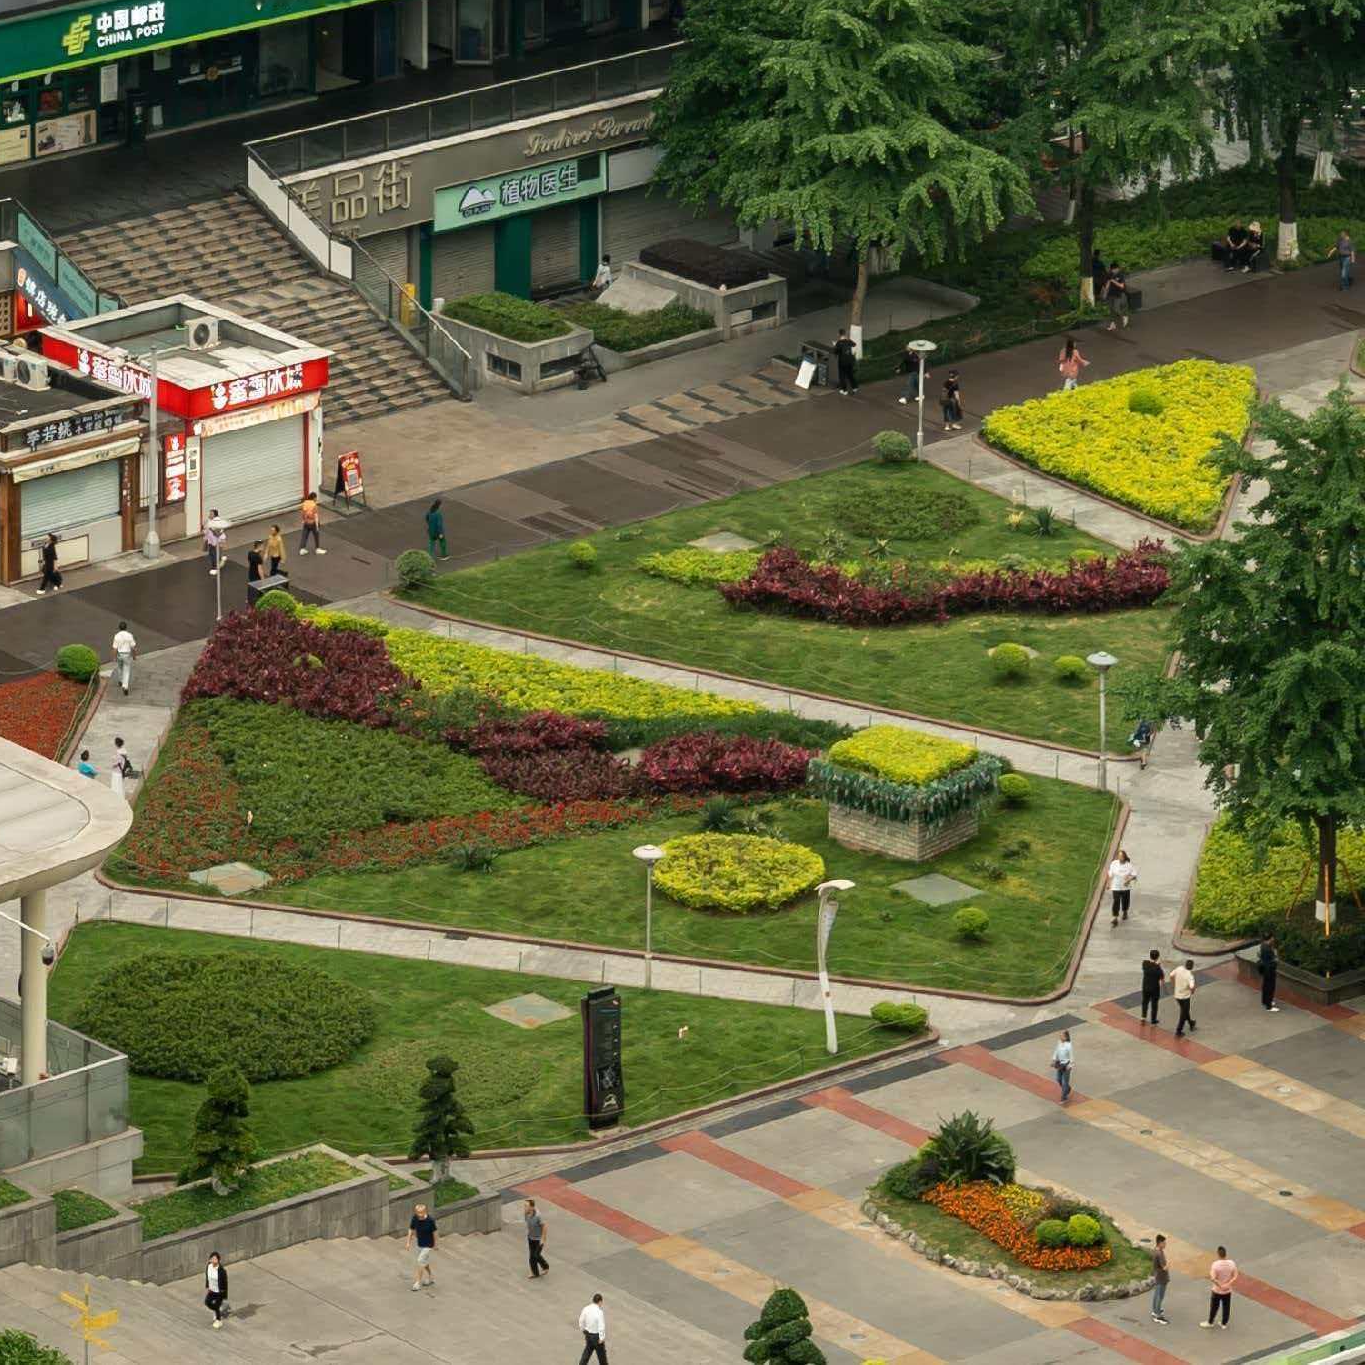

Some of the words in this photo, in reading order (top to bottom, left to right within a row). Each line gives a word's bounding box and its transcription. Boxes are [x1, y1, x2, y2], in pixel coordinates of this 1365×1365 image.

[96, 0, 166, 32] 中国邮政
[96, 29, 132, 48] CHINA
[135, 21, 166, 41] POST
[500, 165, 579, 207] 植物医生
[228, 363, 303, 405] 蜜雪冰城
